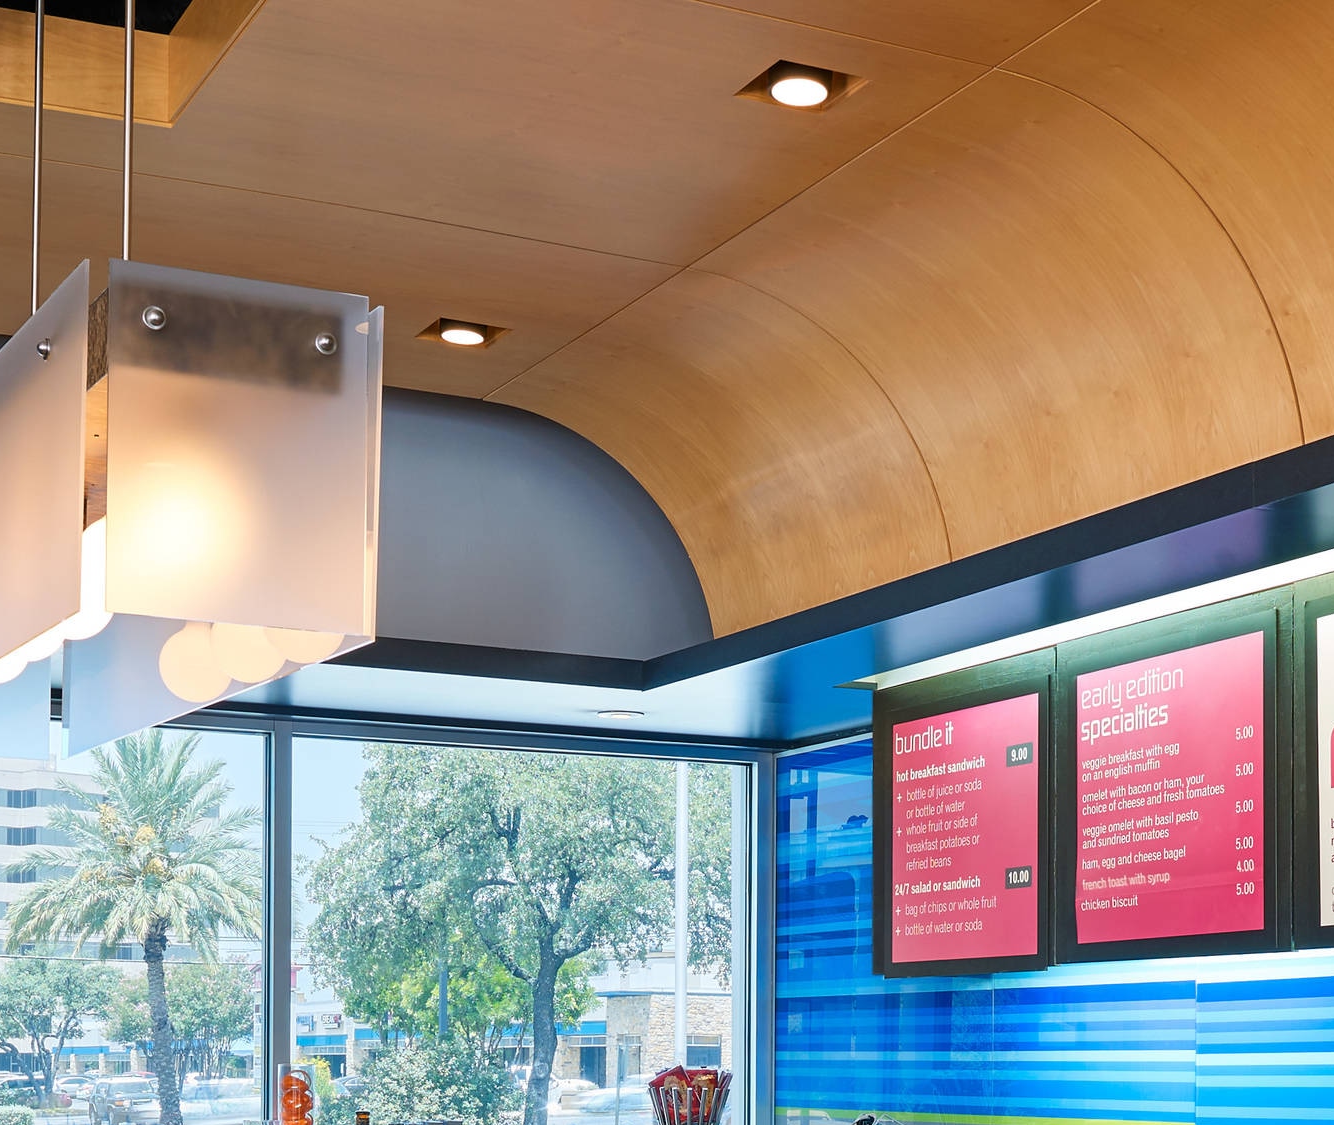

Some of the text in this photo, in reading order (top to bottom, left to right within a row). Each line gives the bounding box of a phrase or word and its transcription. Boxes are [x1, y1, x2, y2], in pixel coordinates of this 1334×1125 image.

[1081, 666, 1183, 709] early edition
[895, 720, 954, 755] bundle it
[1080, 701, 1169, 745] specialties
[896, 746, 1027, 782] hot breakfast sandwich 9.00
[1081, 835, 1254, 870] ham, egg and cheese bagel 5.00
[894, 869, 1029, 896] 24/7 salad or sandwich 10.00
[1080, 881, 1255, 911] chicken biscuit 5.00
